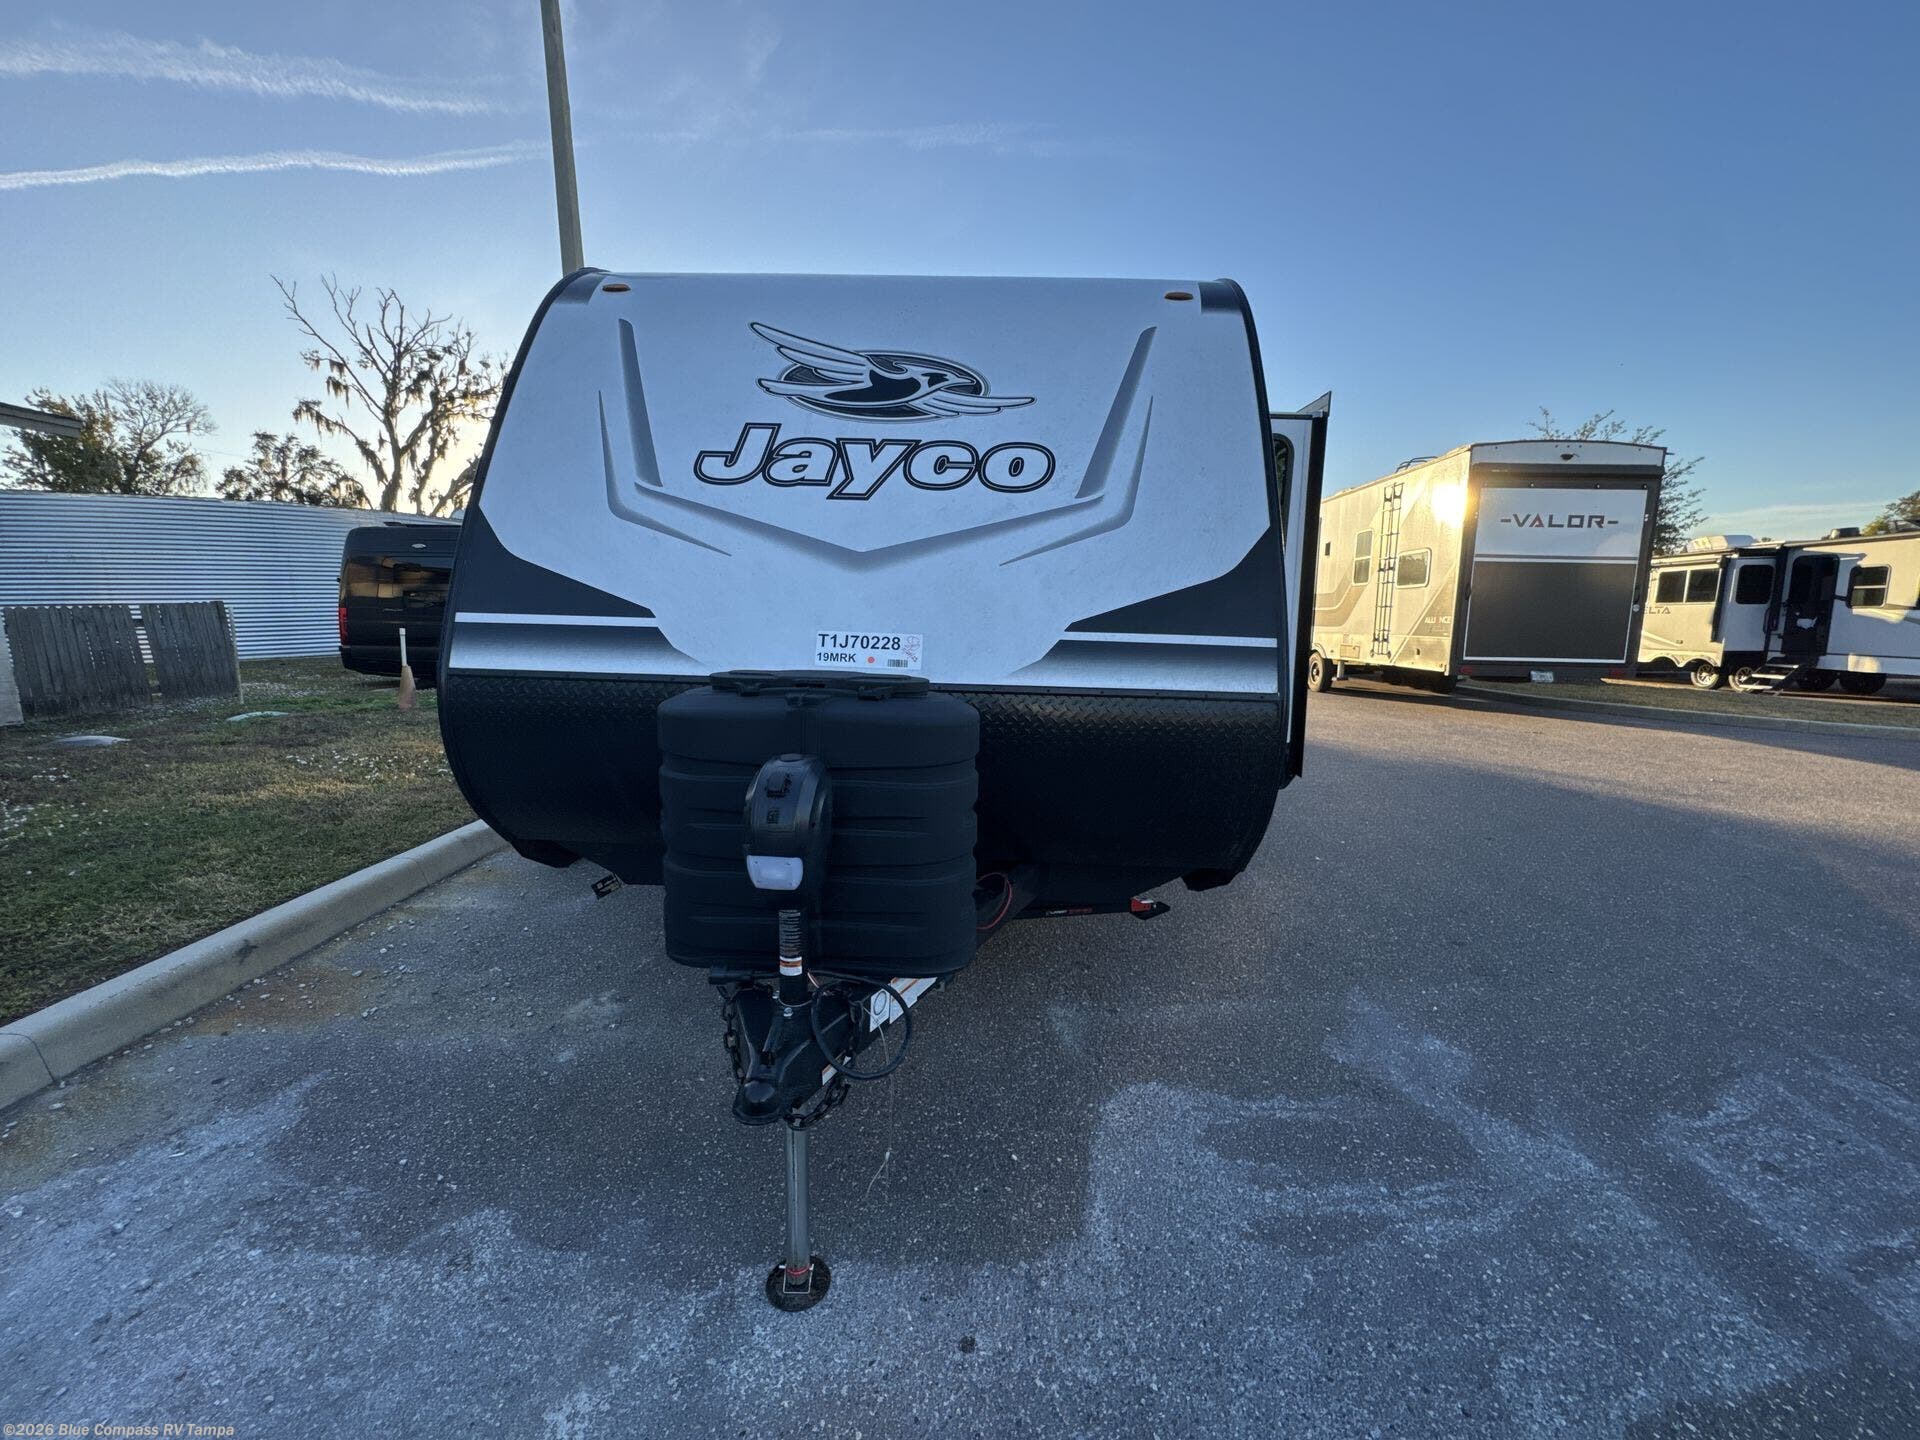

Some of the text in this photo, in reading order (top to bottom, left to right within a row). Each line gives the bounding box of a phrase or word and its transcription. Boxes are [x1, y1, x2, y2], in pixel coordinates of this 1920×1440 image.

[693, 422, 1056, 501] Jayco
[818, 633, 901, 651] T1J70228
[816, 652, 857, 663] 19MRK
